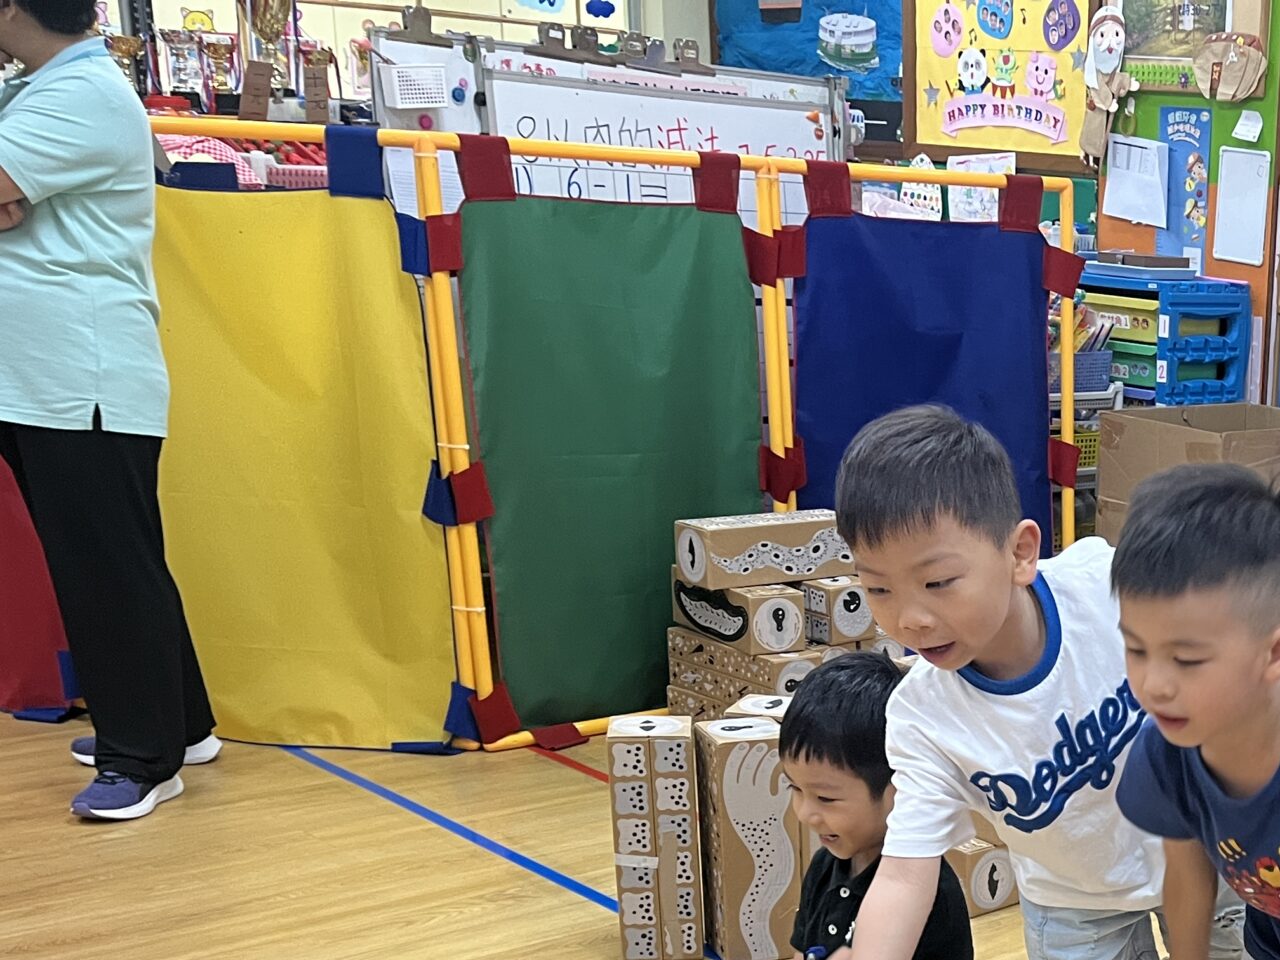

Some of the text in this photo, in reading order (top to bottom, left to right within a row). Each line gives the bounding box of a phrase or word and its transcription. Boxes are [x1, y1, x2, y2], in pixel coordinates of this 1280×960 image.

[947, 103, 1061, 129] HAPPY BIRTHDAY
[1158, 364, 1166, 379] 2
[970, 679, 1147, 828] Dodger
